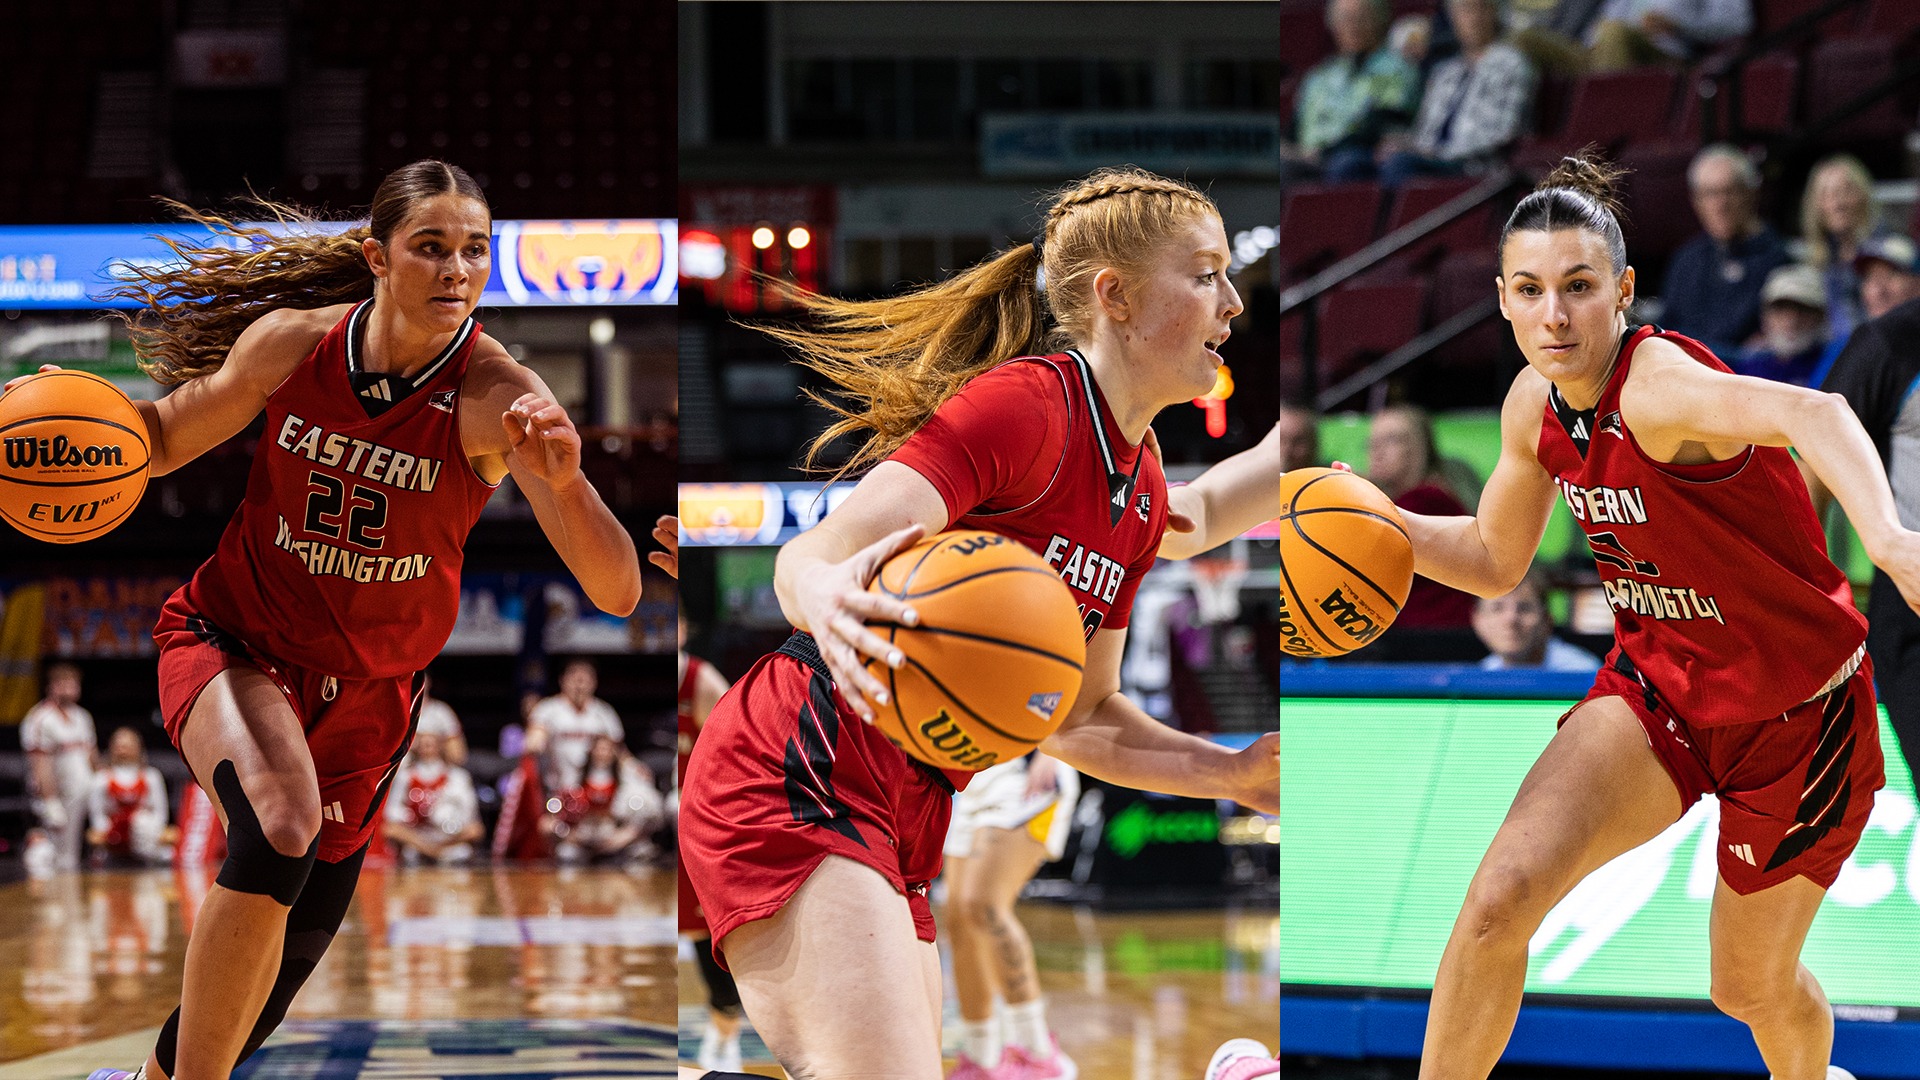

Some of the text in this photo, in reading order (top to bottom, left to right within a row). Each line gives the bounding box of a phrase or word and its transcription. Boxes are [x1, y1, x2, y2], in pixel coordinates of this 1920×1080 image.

[3, 434, 124, 469] Wilson
[277, 412, 443, 493] EASTERN
[28, 491, 123, 523] EVO NXT
[303, 469, 389, 551] 22
[1319, 587, 1385, 645] NCAA
